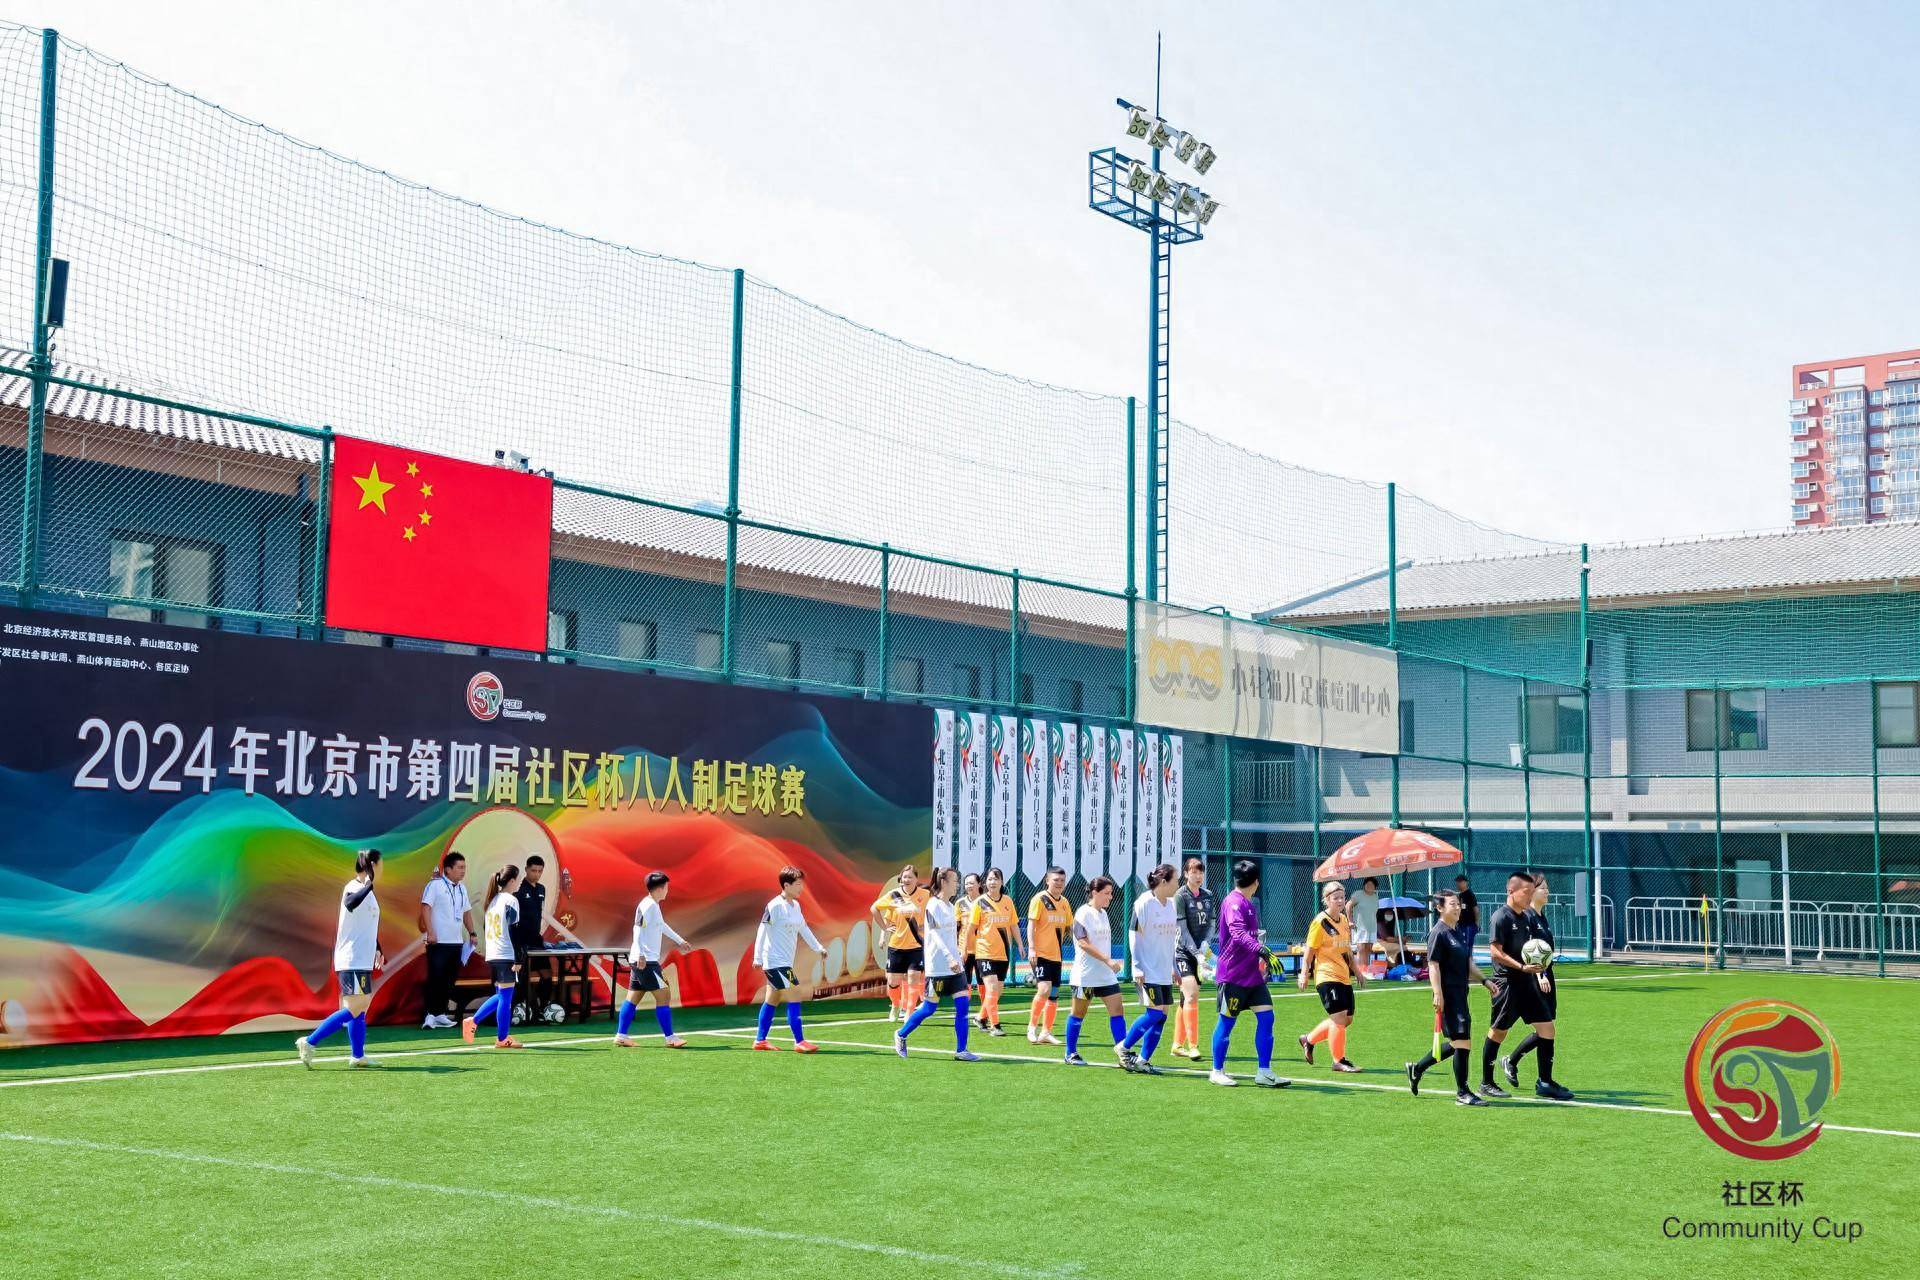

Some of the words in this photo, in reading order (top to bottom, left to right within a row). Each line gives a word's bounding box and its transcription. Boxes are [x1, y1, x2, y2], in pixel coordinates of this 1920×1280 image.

[74, 717, 806, 816] 2024年北京市第四届社区杯八人制足球赛
[936, 749, 946, 850] 北京市东城区
[1197, 911, 1207, 925] 12
[981, 961, 992, 972] 24
[1177, 961, 1188, 972] 12
[1229, 996, 1239, 1011] 12
